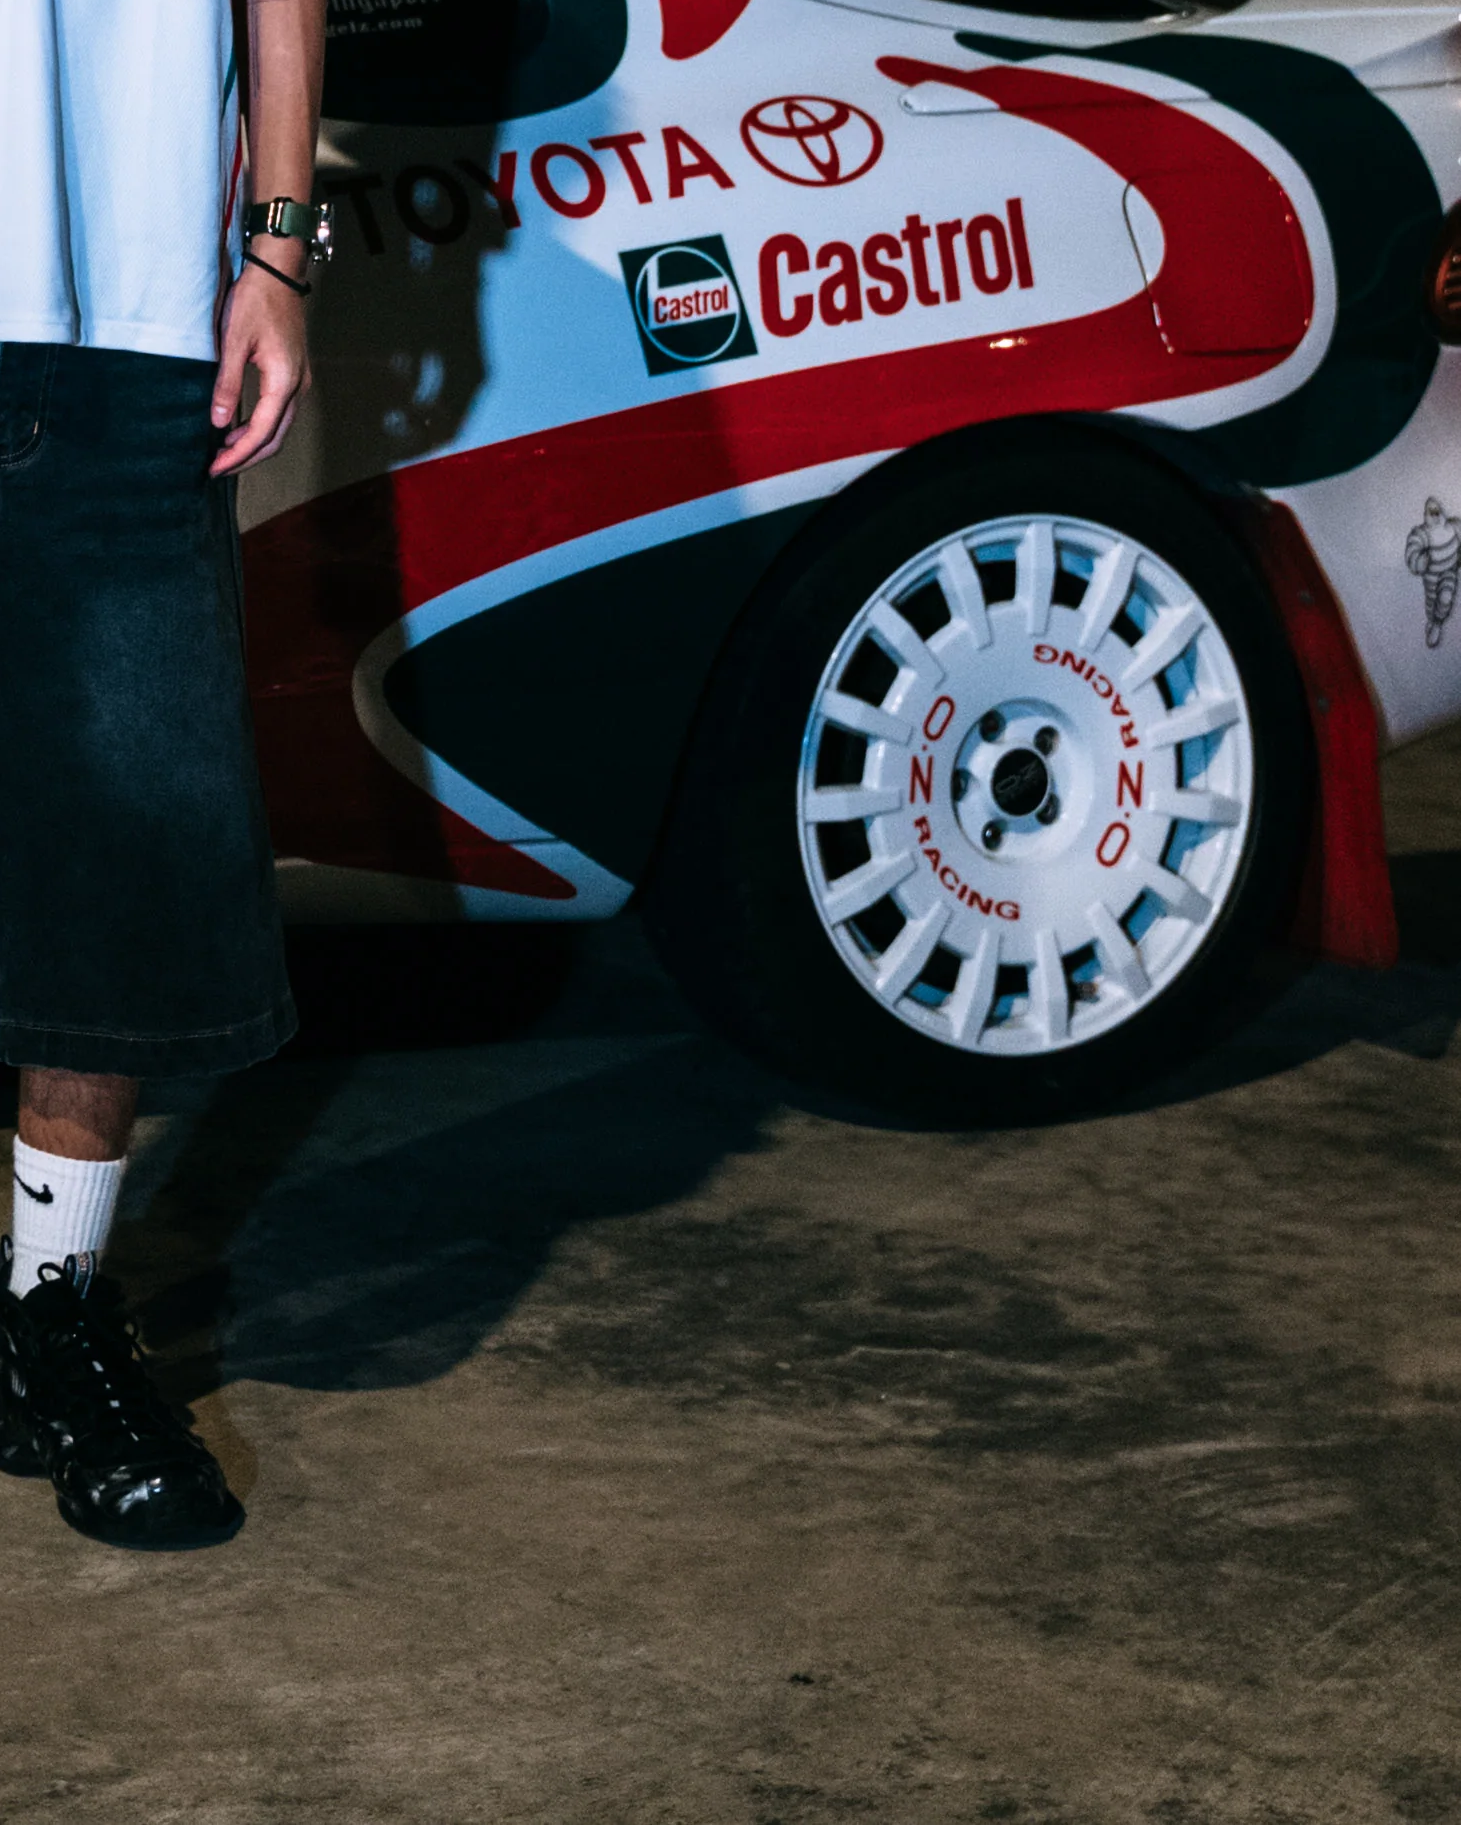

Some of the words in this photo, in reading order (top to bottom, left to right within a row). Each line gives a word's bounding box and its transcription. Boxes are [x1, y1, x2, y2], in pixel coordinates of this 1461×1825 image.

[323, 126, 736, 256] TOYOTA
[653, 284, 730, 324] Castrol
[758, 197, 1034, 338] Castrol
[1033, 643, 1139, 749] RACING
[914, 815, 1021, 921] RACING
